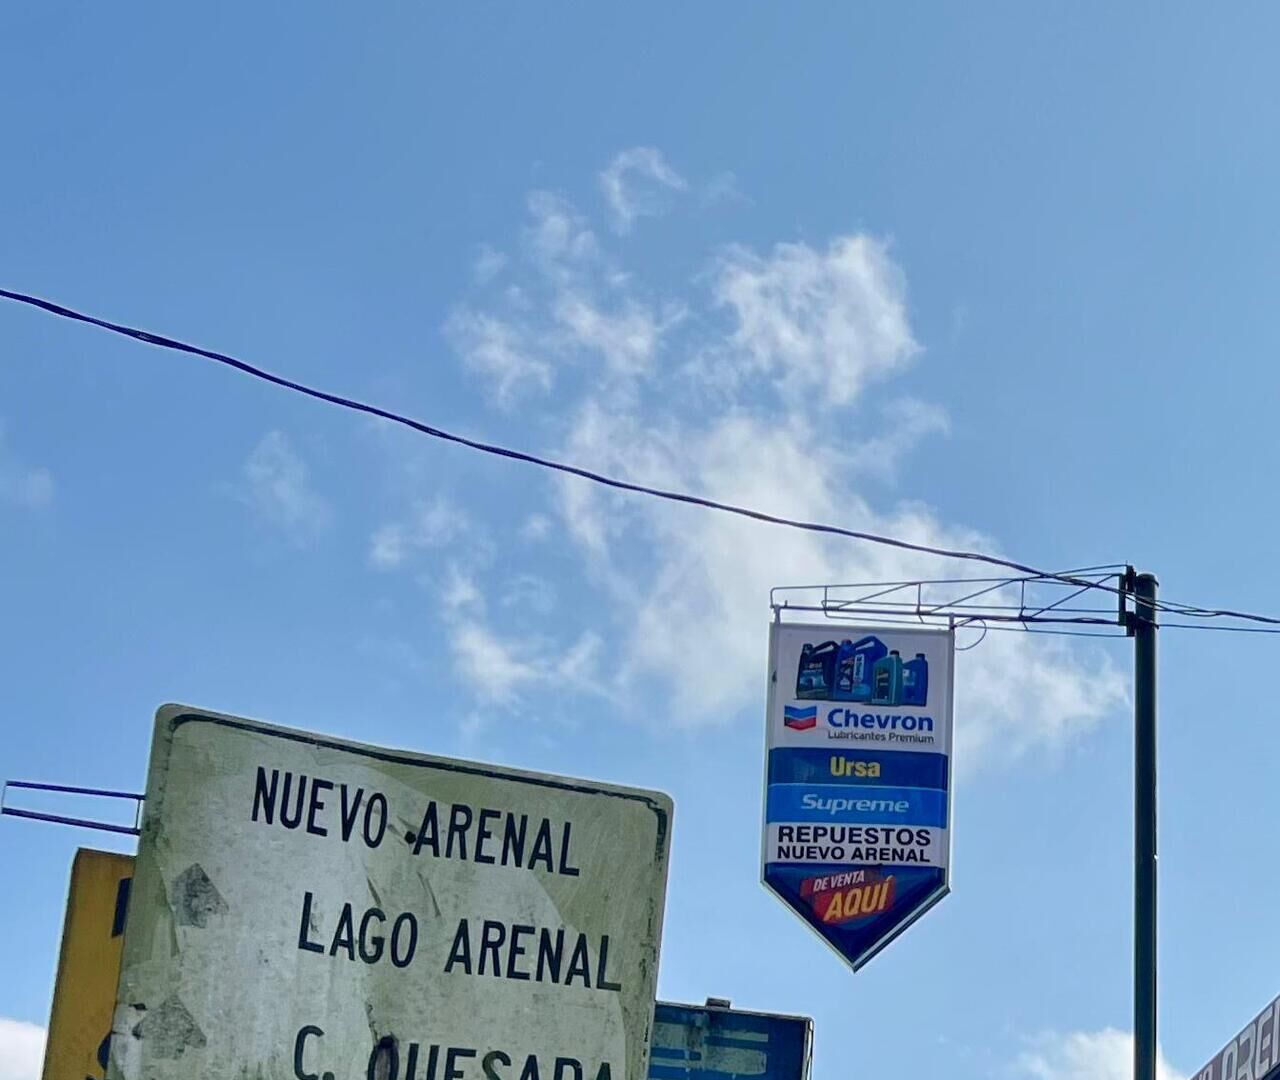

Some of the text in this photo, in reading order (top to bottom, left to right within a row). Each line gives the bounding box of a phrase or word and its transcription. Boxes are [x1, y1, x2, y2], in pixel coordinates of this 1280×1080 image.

[827, 707, 934, 732] Chevron
[827, 729, 935, 745] Lubricantes Premium
[830, 756, 881, 778] Ursa
[801, 792, 910, 818] Supreme
[251, 766, 581, 877] NUEVO ARENAL
[777, 825, 931, 847] REPUESTOS
[777, 846, 931, 863] NUEVO ARENAL
[813, 869, 865, 893] DE VENTA
[824, 874, 894, 922] AQUÍ
[299, 892, 623, 992] LAGO ARENAL
